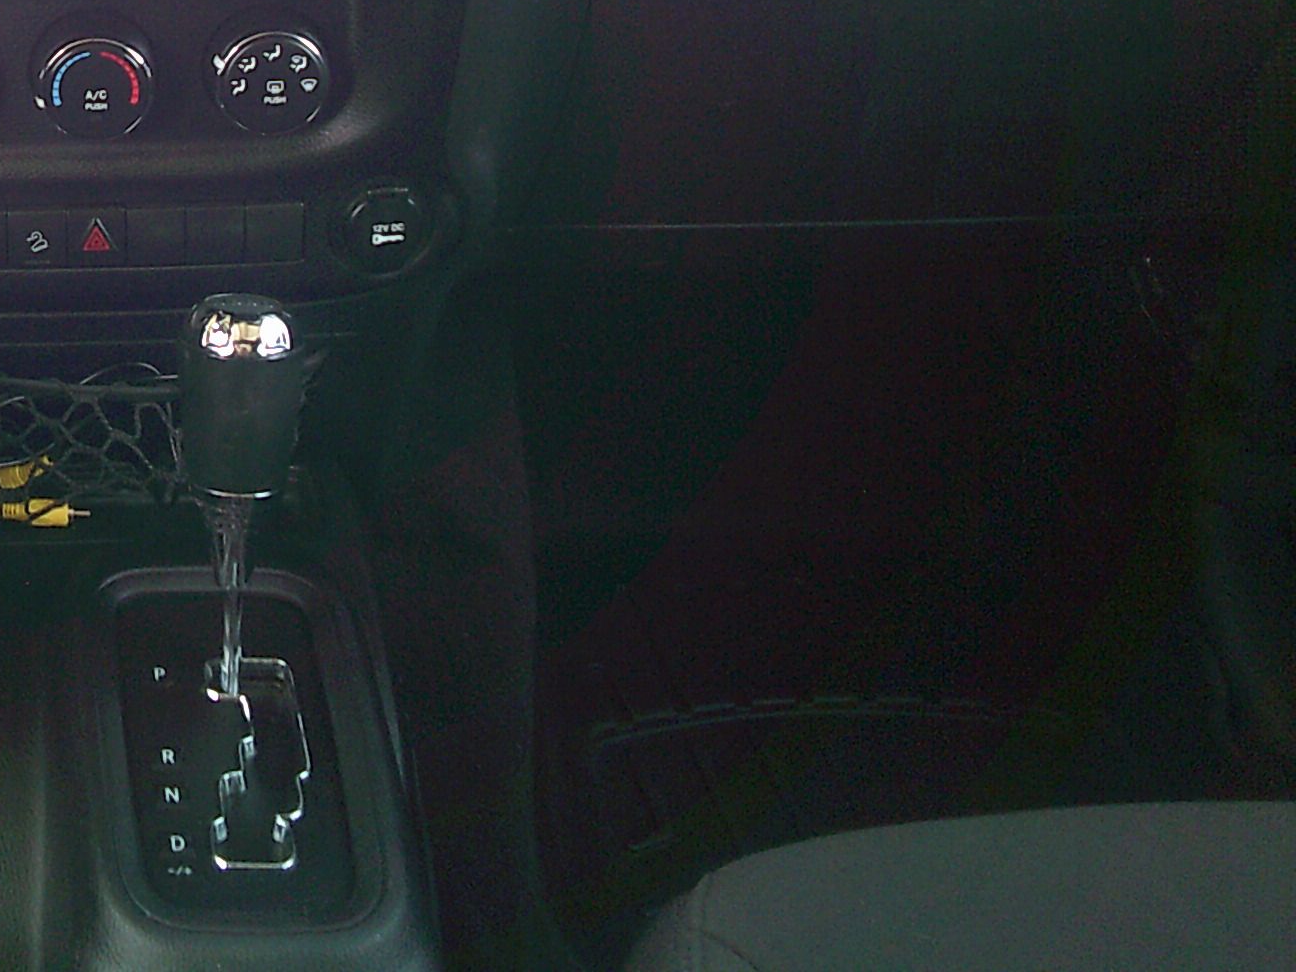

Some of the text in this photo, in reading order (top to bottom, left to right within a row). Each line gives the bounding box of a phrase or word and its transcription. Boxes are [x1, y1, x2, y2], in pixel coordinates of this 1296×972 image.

[85, 89, 107, 101] A/C
[263, 95, 287, 104] PUSH
[84, 102, 108, 111] PUSH
[153, 667, 166, 681] P
[161, 748, 175, 765] R
[164, 786, 180, 804] N
[170, 834, 186, 852] D
